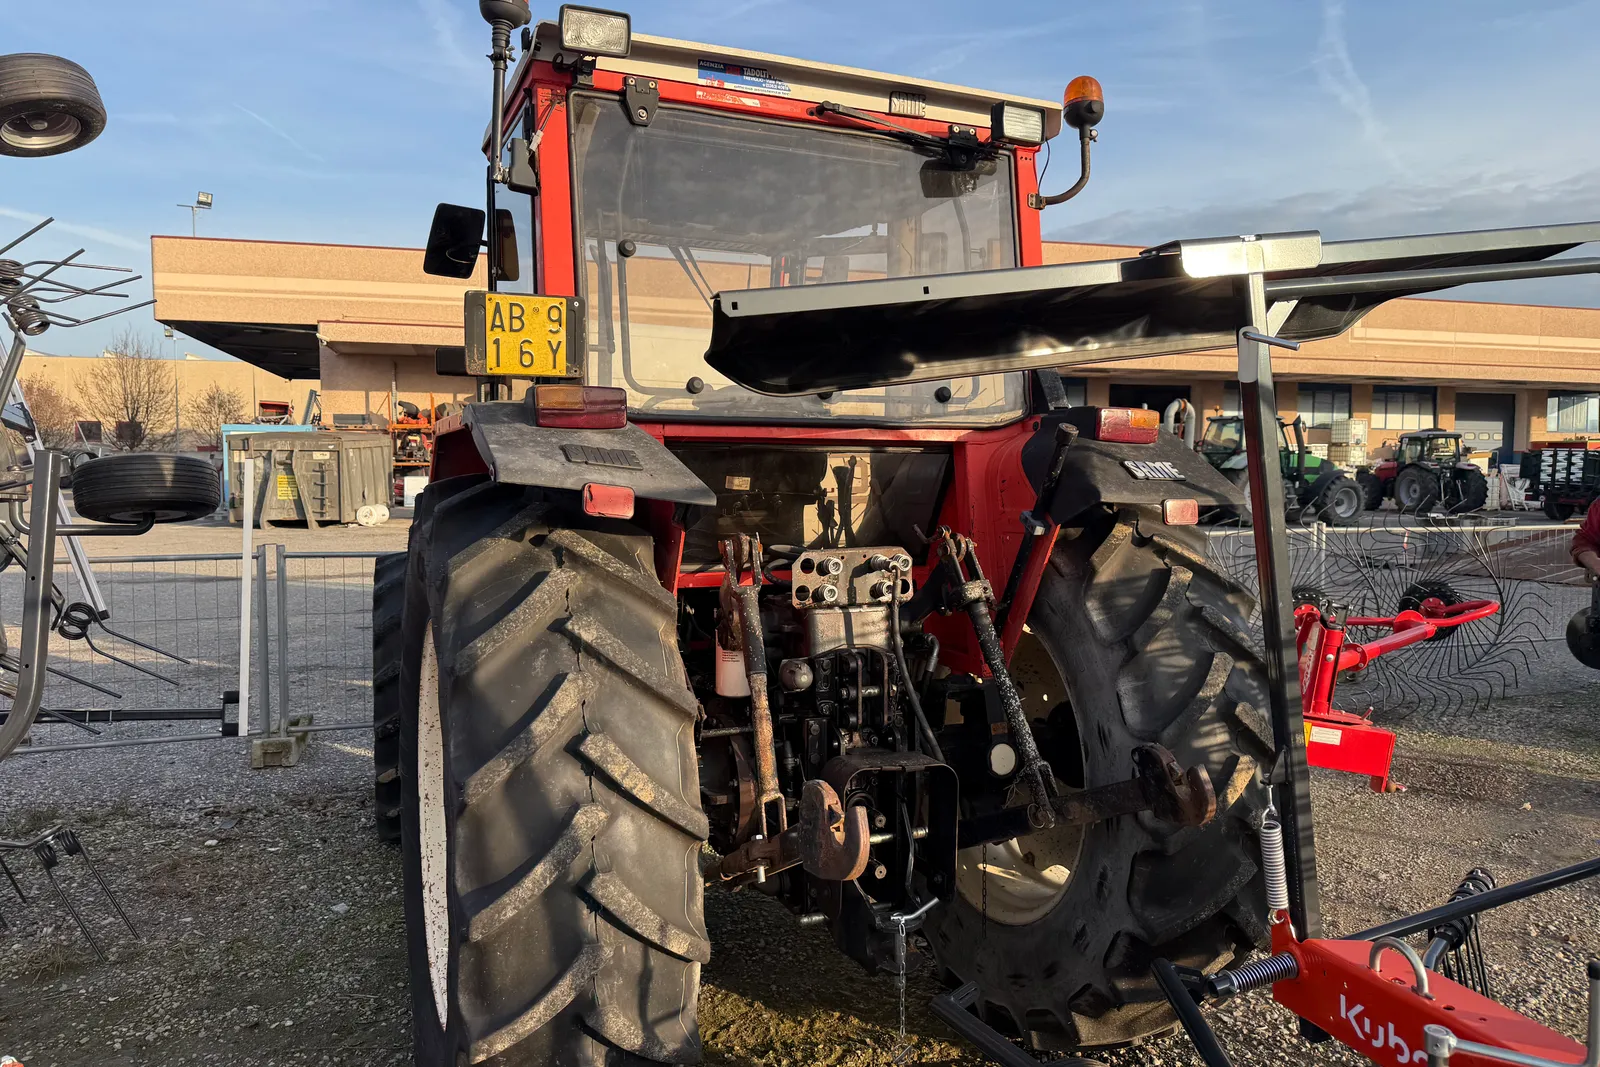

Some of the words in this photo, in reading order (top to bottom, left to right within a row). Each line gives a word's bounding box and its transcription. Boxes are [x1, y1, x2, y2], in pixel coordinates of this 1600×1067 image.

[700, 61, 724, 69] AGENZIA
[490, 301, 525, 332] AB
[547, 304, 562, 334] 9
[1123, 460, 1186, 480] SAME
